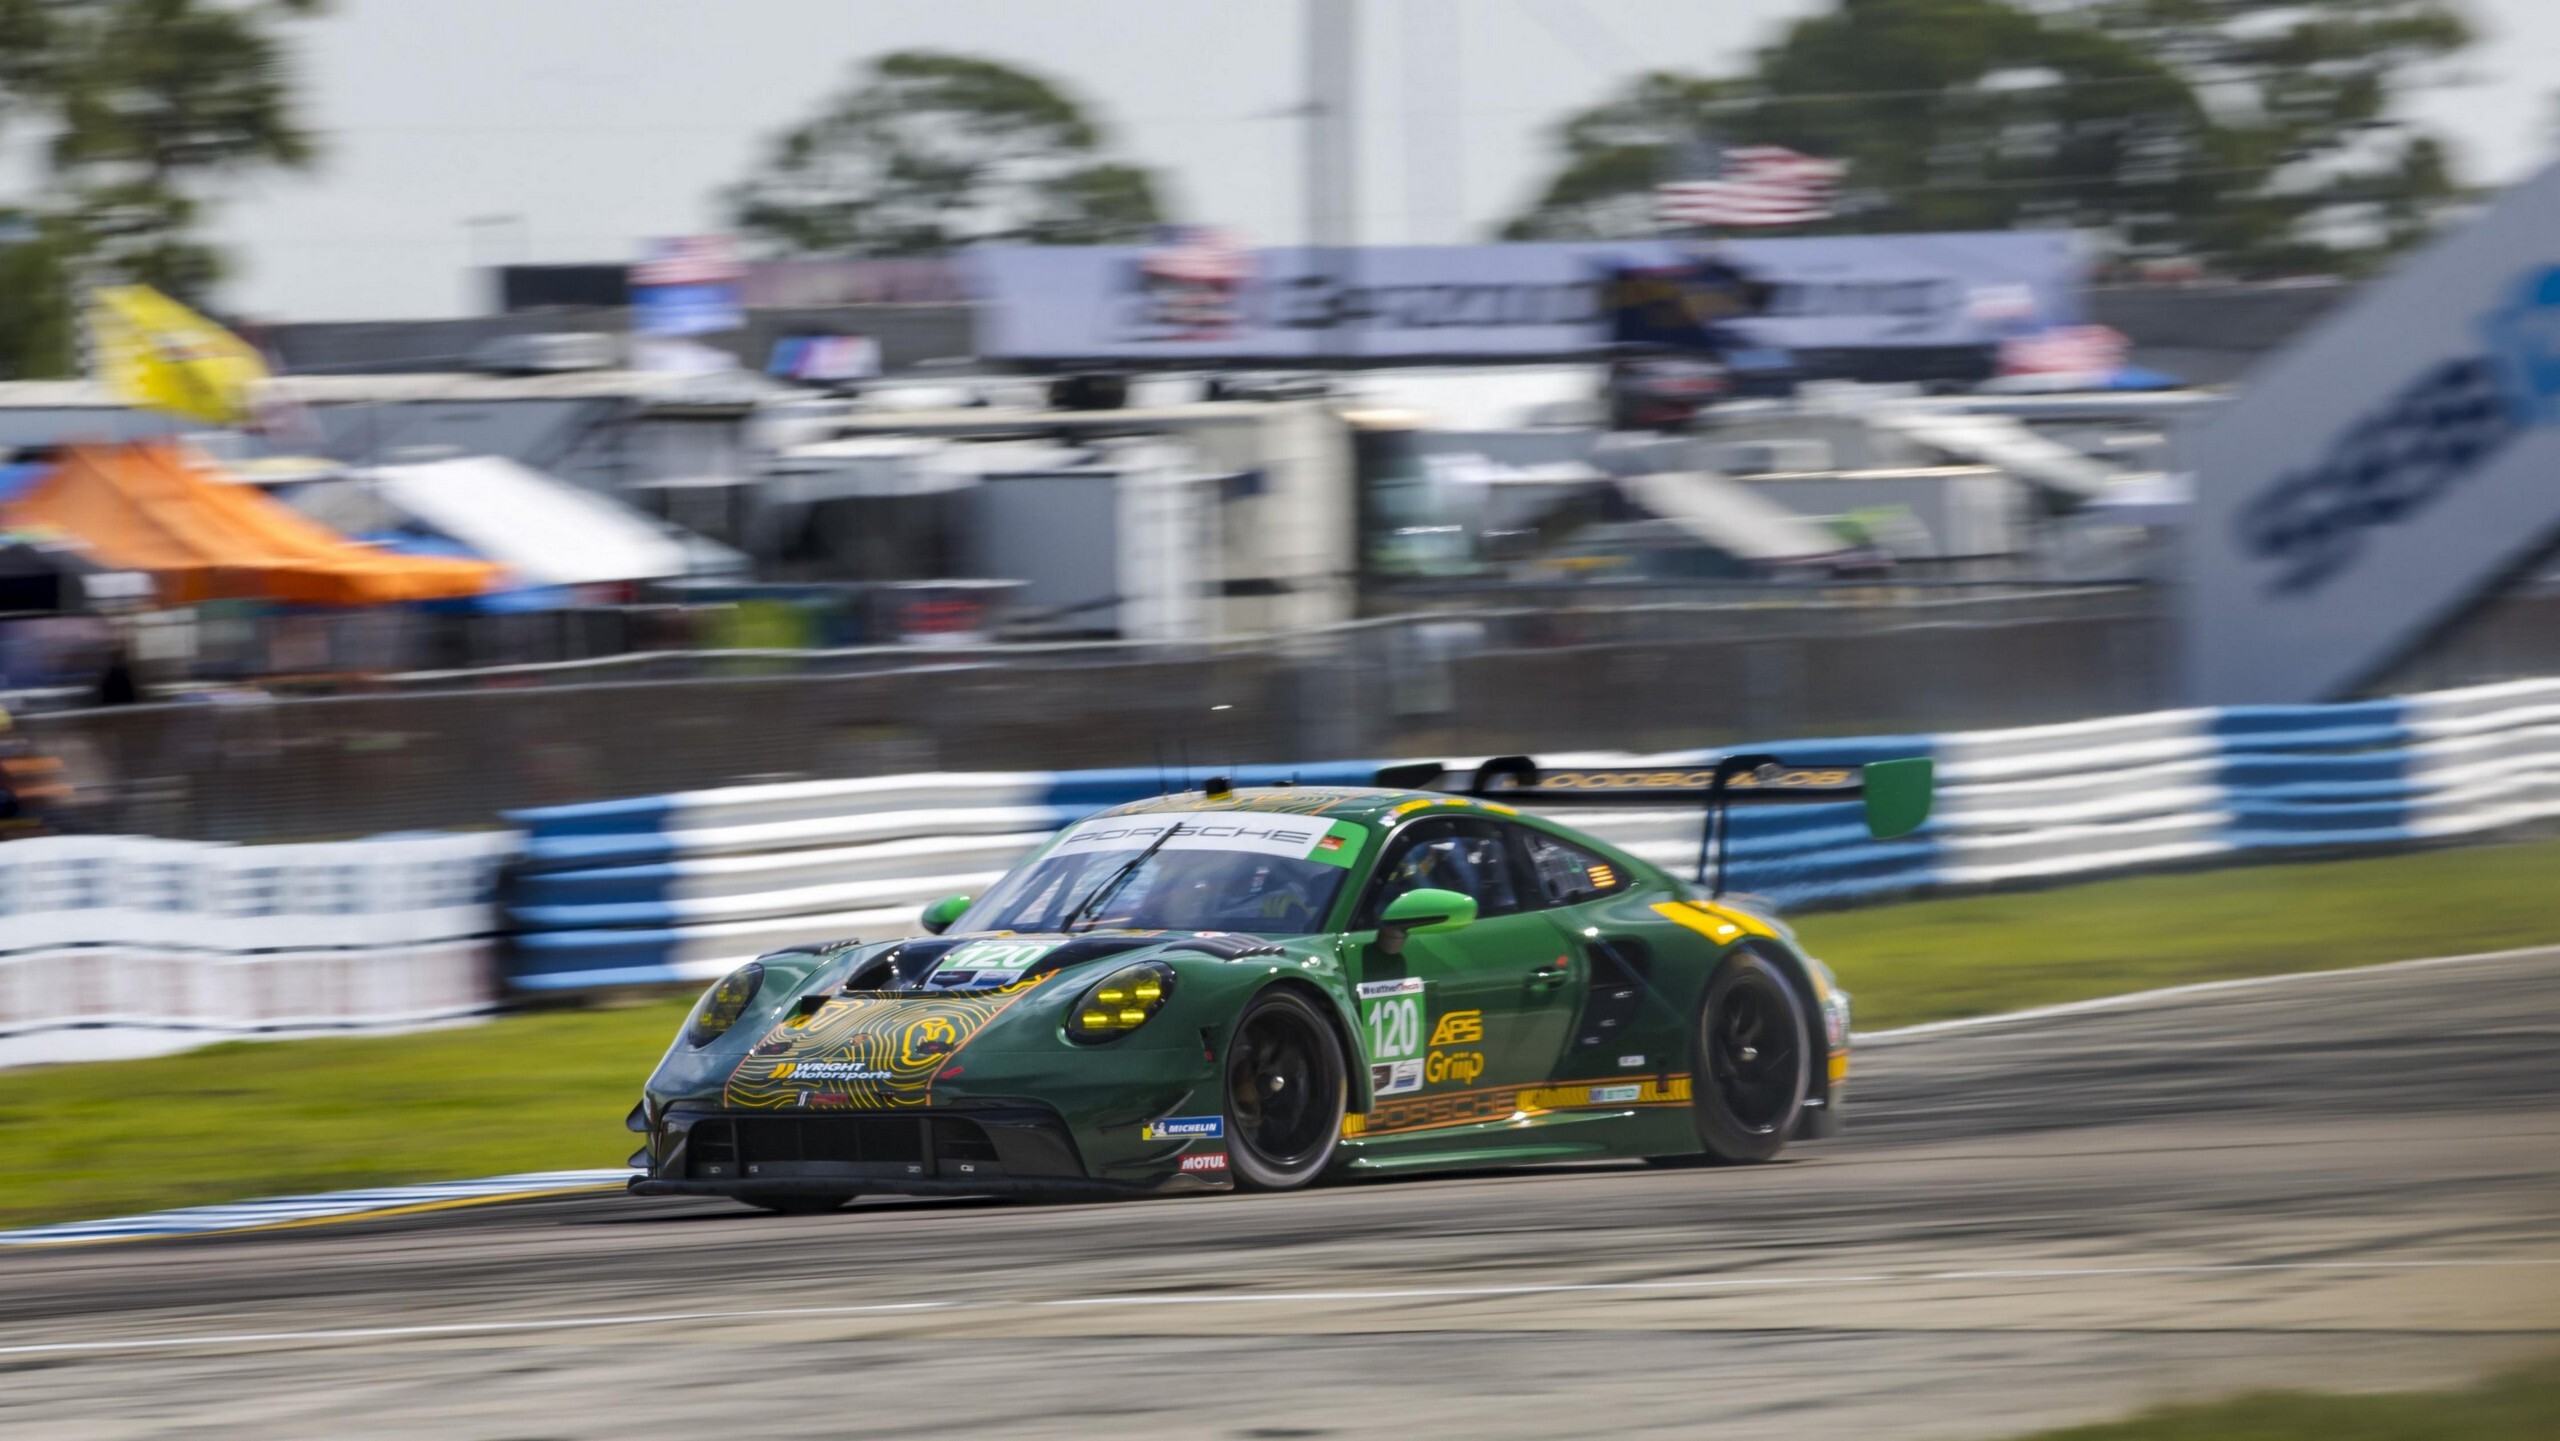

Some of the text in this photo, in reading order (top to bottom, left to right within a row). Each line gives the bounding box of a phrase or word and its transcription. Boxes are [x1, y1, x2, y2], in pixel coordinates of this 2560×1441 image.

[1063, 826, 1313, 846] PORSCHE
[953, 945, 1049, 968] 120
[1369, 998, 1418, 1059] 120
[1428, 1008, 1483, 1047] APS
[787, 1070, 893, 1081] Motorsports
[796, 1062, 866, 1072] WRIGHT
[1366, 1091, 1517, 1131] PORSCHE
[1168, 1123, 1217, 1133] MICHELIN
[1181, 1155, 1225, 1170] MOTUL
